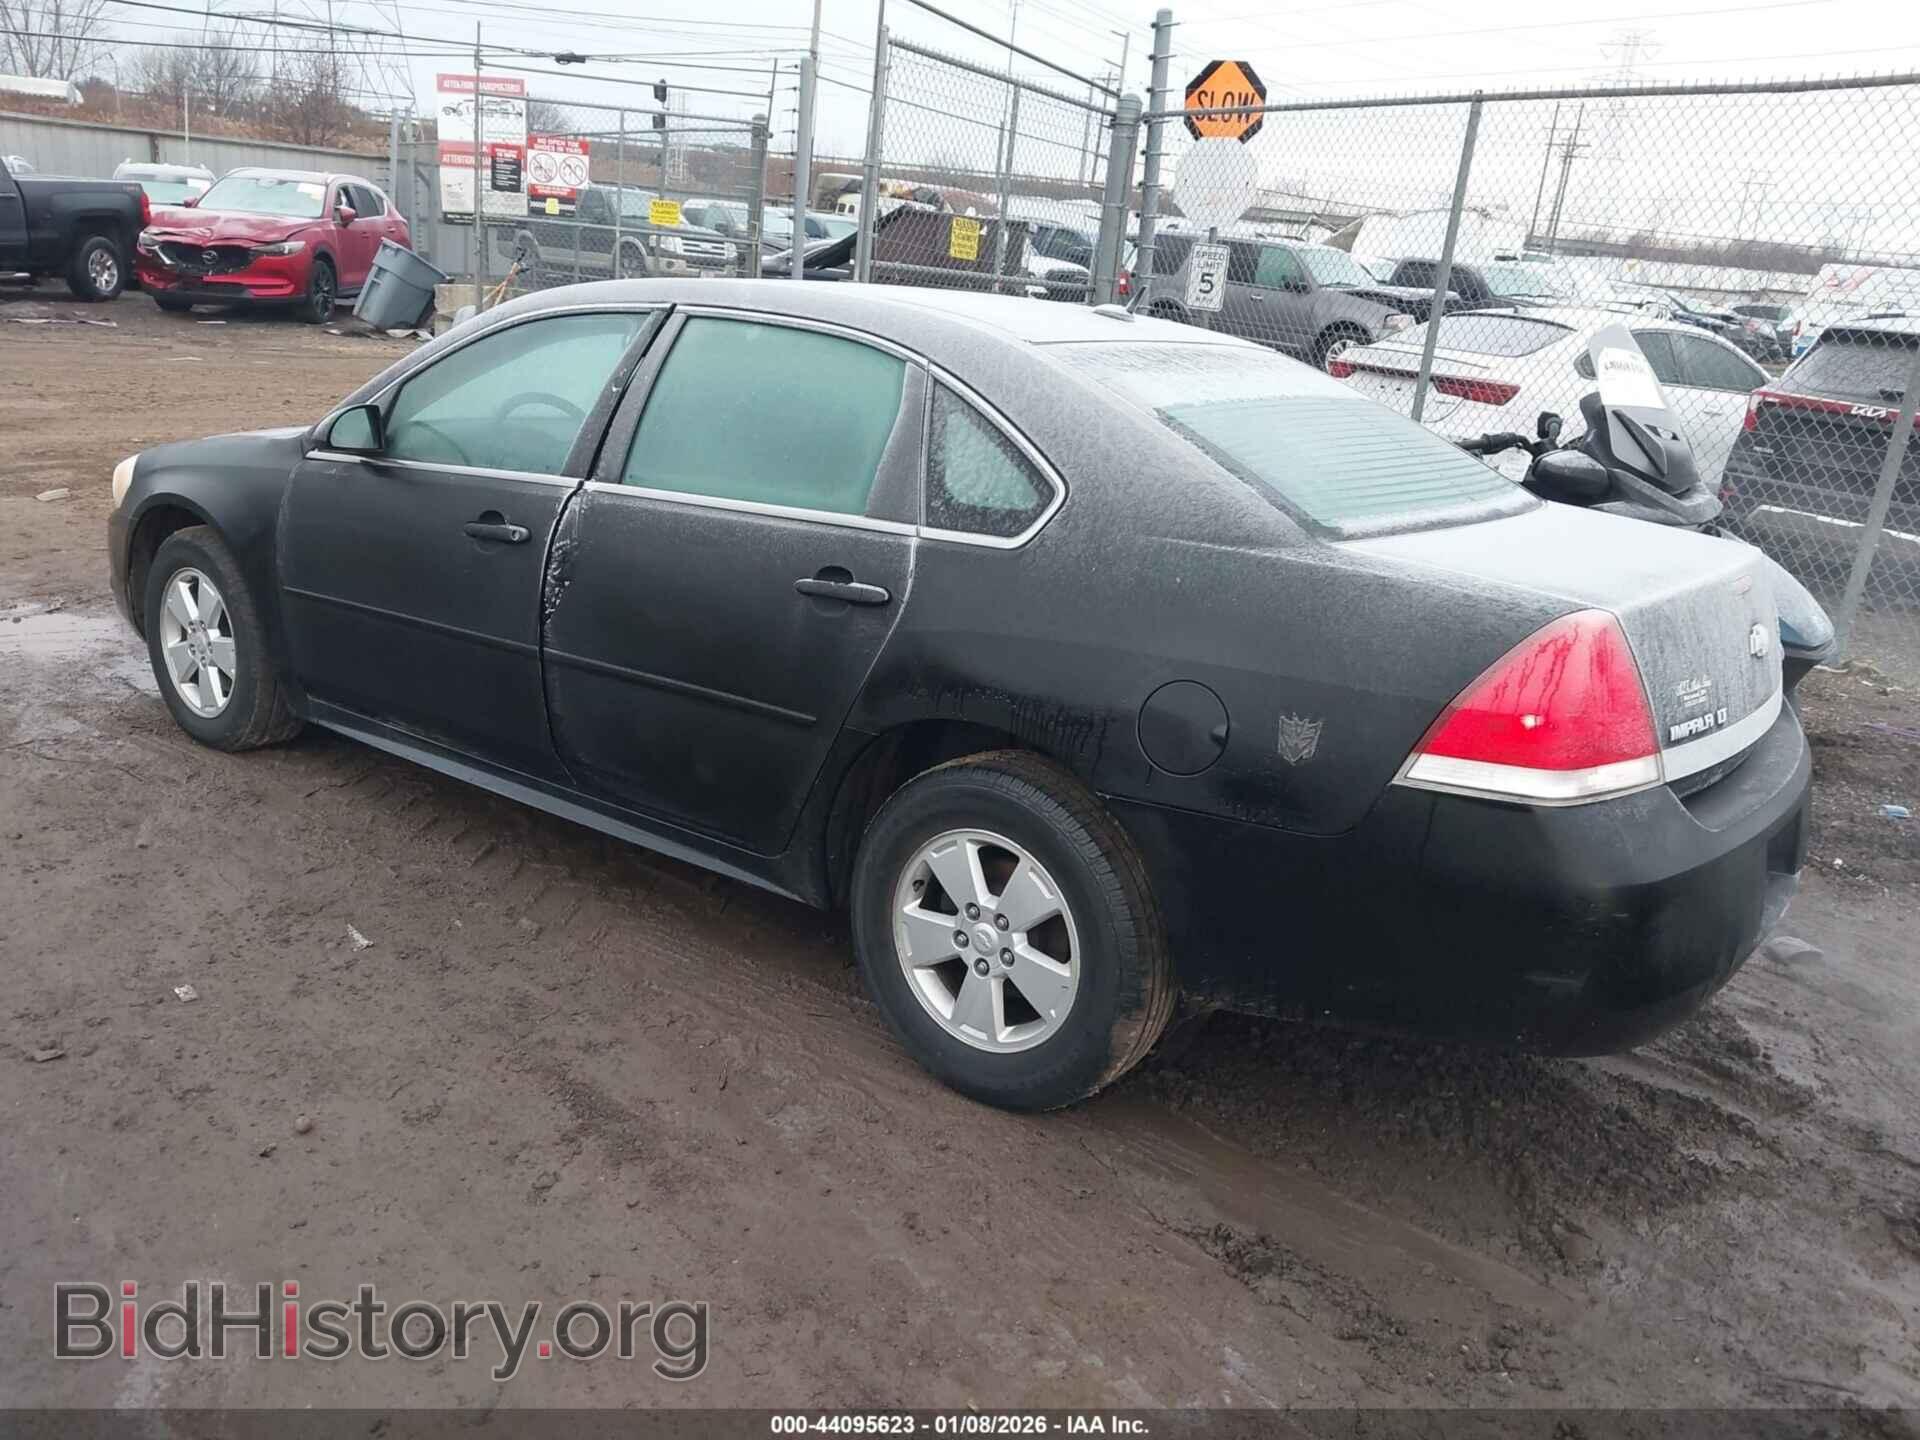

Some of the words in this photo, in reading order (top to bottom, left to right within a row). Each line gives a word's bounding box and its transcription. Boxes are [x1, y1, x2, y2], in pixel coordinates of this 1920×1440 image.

[1196, 90, 1255, 123] SLOW
[1195, 250, 1225, 261] SPEED
[1197, 260, 1223, 271] LIMIT
[1199, 272, 1215, 294] 5
[1670, 713, 1715, 741] IMPALA
[1717, 707, 1727, 724] LT
